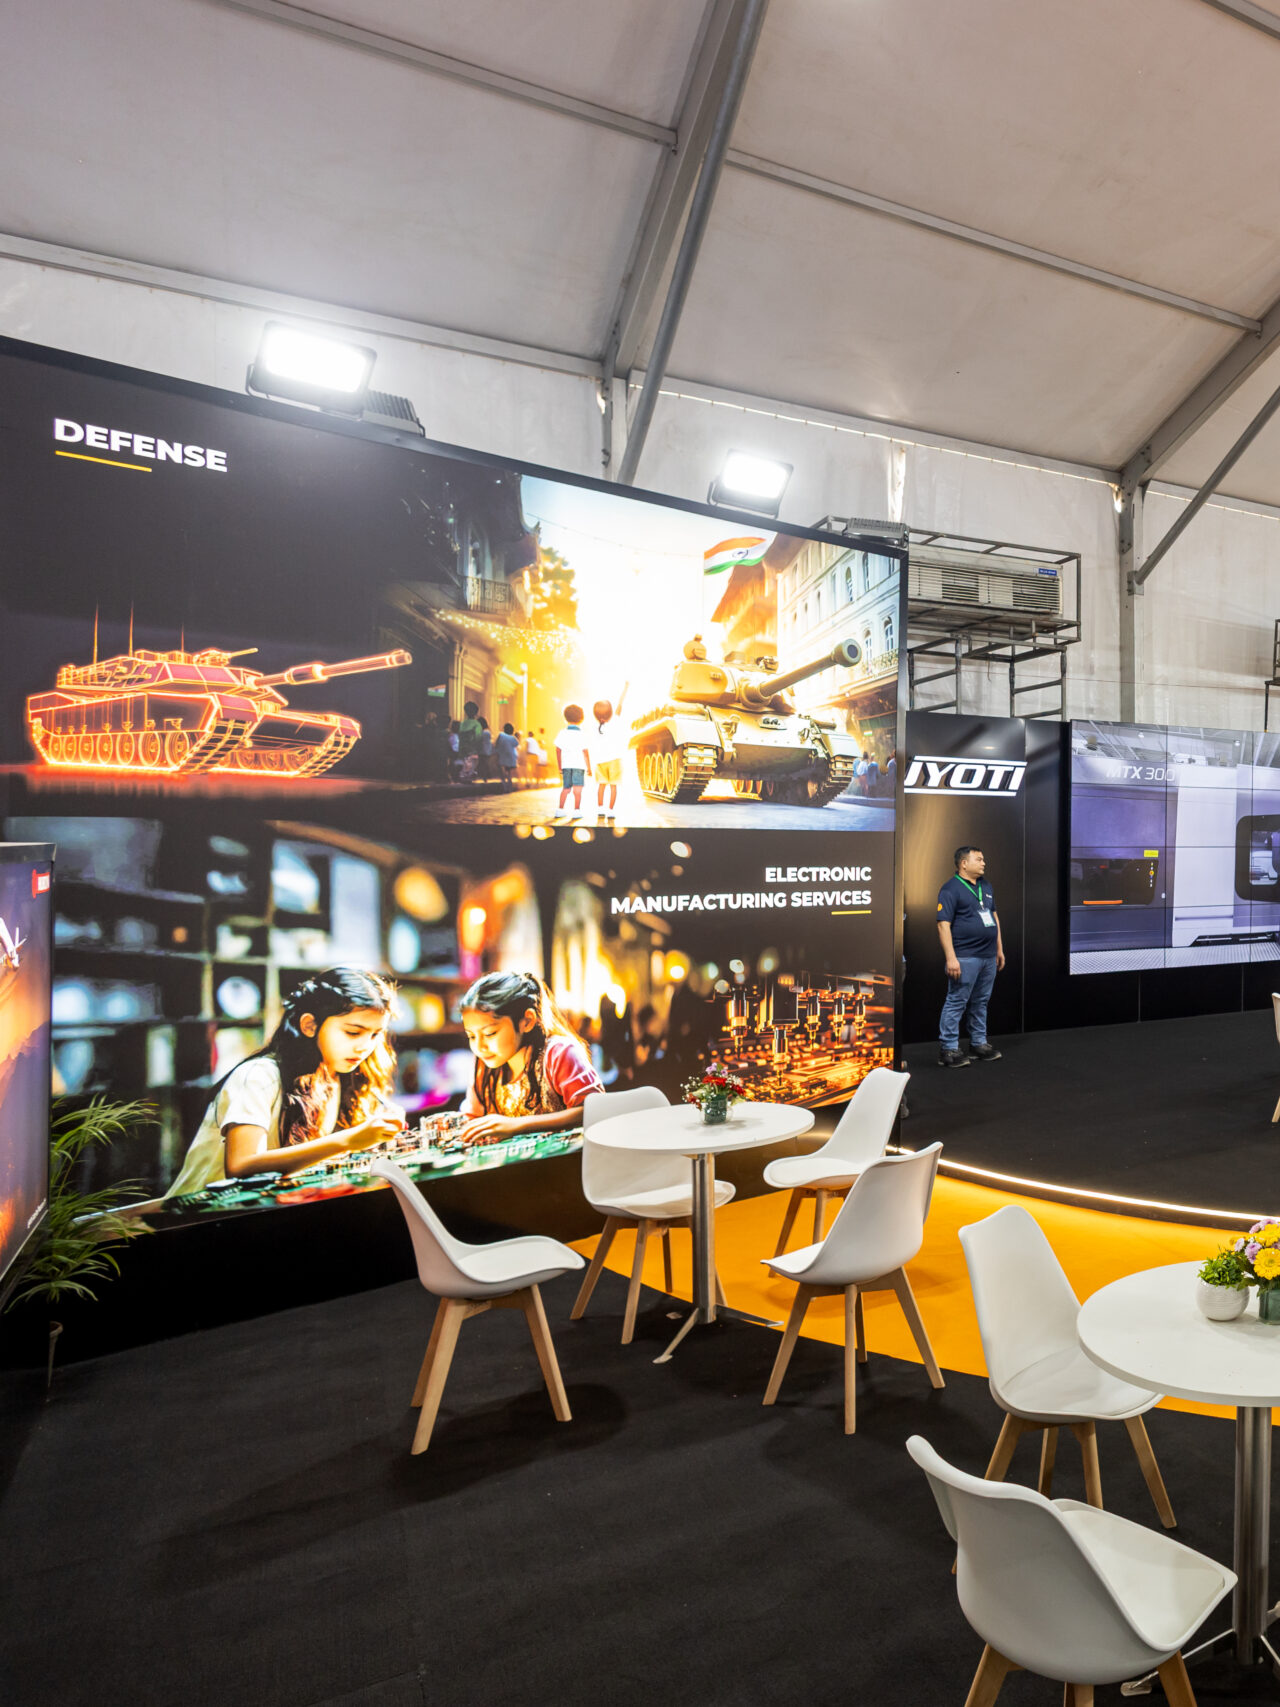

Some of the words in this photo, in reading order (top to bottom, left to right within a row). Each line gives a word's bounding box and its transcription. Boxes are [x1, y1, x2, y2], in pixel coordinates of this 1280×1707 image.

[54, 418, 228, 472] DEFENSE
[904, 761, 1025, 791] JYOTI
[765, 867, 872, 883] ELECTRONIC
[611, 892, 787, 914] MANUFACTURING
[791, 890, 872, 908] SERVICES
